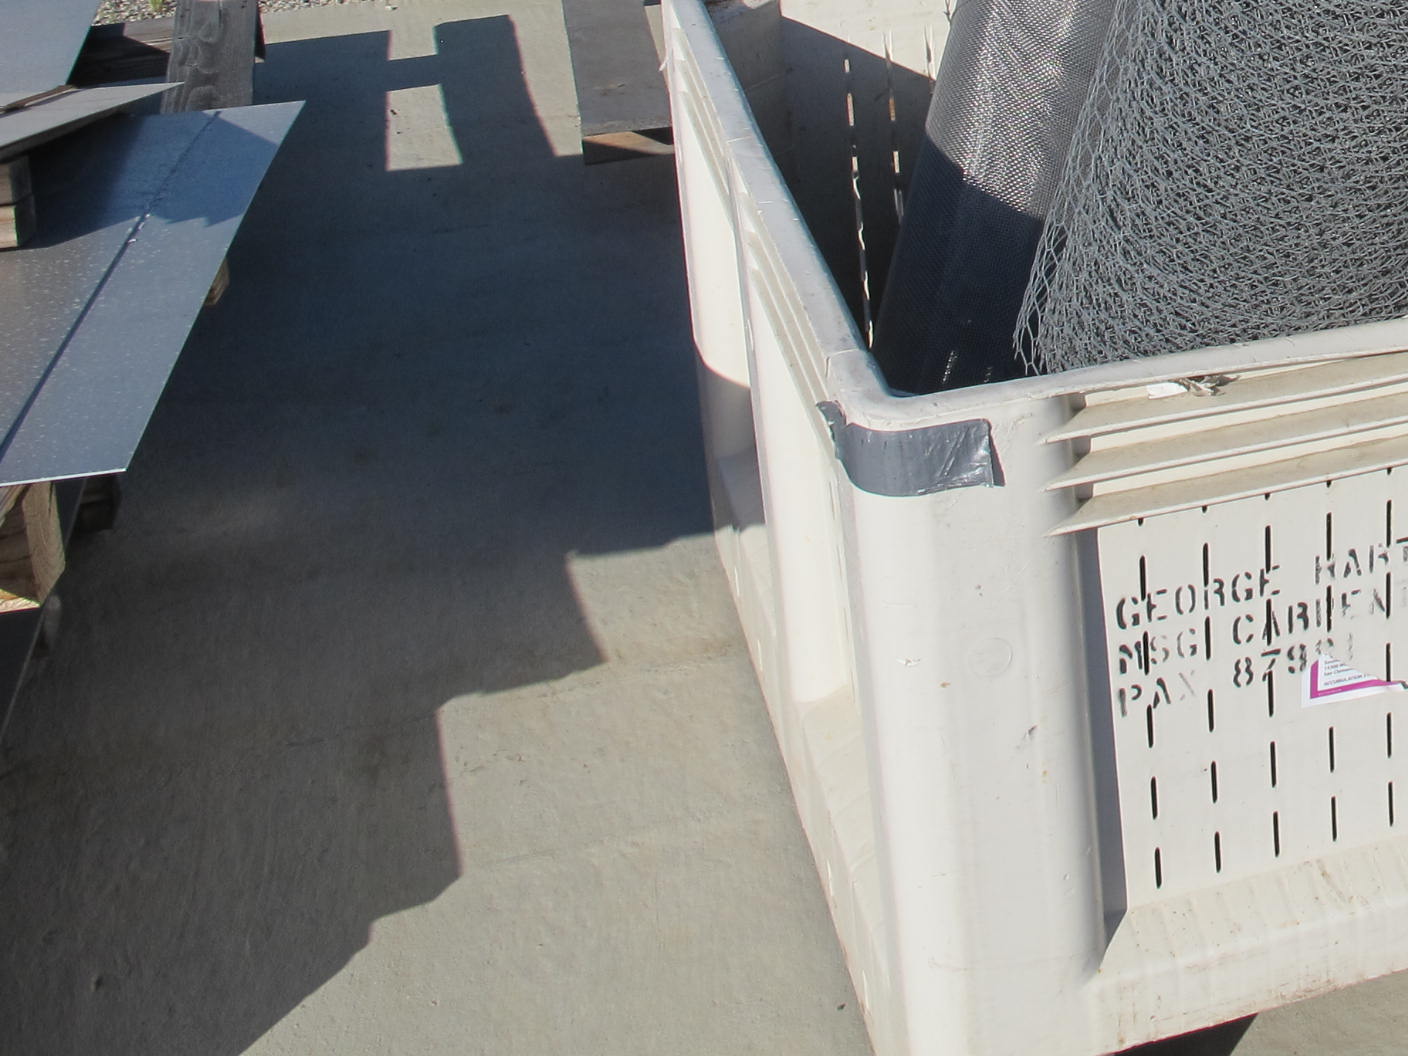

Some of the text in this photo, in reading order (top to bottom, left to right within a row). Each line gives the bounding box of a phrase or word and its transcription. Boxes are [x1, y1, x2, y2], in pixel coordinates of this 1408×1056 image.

[1116, 564, 1281, 630] GEORGE
[1119, 627, 1198, 675] MSG
[1119, 669, 1195, 717] PAX
